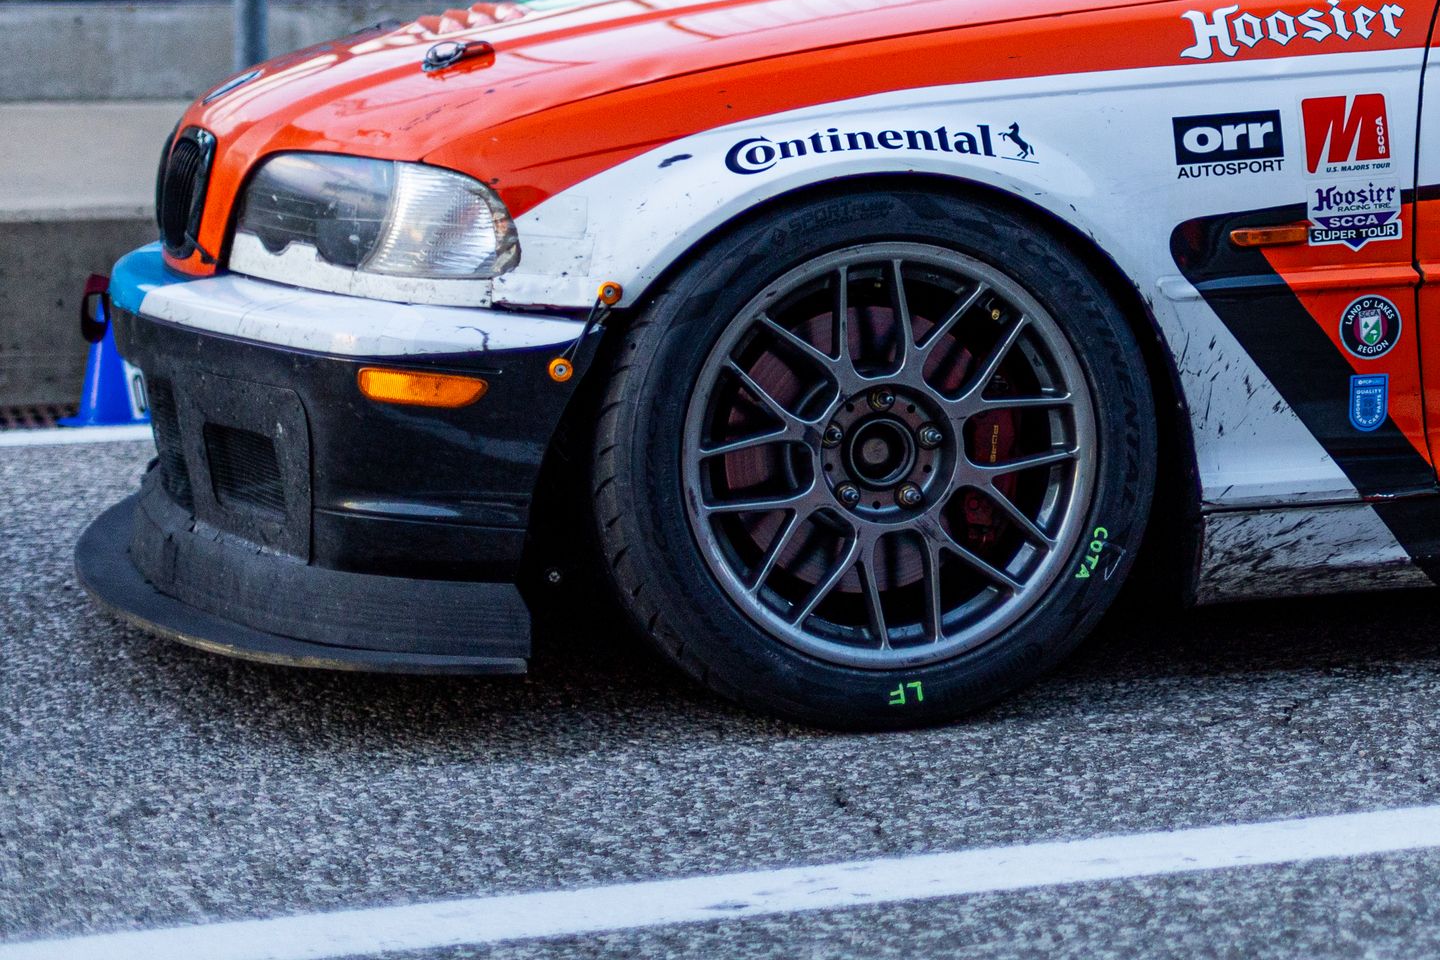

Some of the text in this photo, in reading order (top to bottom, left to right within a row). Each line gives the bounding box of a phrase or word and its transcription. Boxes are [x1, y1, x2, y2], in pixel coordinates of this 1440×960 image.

[1183, 120, 1274, 154] orr
[1376, 116, 1386, 154] SCCA
[725, 124, 997, 175] Continental
[1177, 160, 1285, 179] AUTOSPORT
[1326, 162, 1391, 173] U.S. MAJORS TOUR
[1312, 182, 1396, 211] Hoosier
[1337, 203, 1371, 212] RACING
[1314, 225, 1395, 241] SUPER TOUR
[1329, 215, 1378, 228] SCCA
[1345, 304, 1362, 325] LAND
[1374, 300, 1395, 319] LAKES
[1357, 340, 1389, 354] REGION
[1075, 527, 1108, 579] COTA
[889, 681, 923, 705] LF
